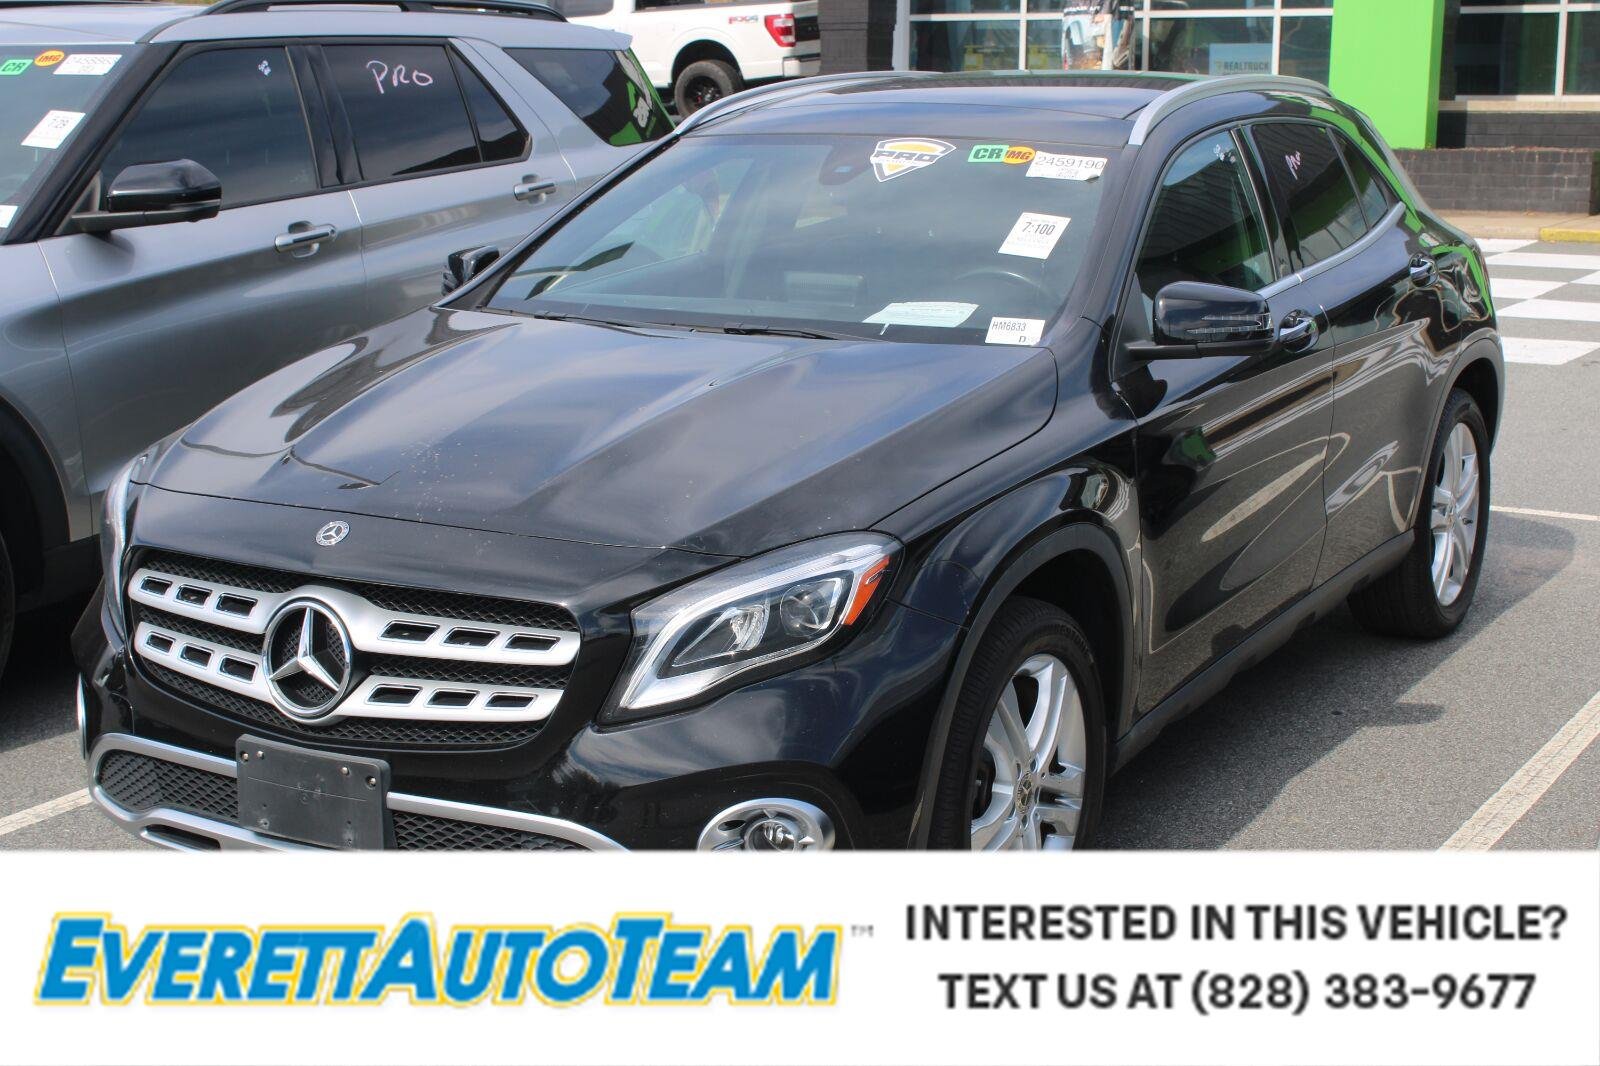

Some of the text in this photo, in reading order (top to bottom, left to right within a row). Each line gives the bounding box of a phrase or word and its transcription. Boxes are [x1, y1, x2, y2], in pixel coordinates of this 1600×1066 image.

[2, 62, 26, 72] CR
[366, 60, 433, 94] PRO
[873, 149, 943, 163] PRO
[973, 147, 1004, 160] CR
[1035, 155, 1105, 171] 2459190
[1022, 221, 1056, 235] 7:100
[991, 319, 1027, 333] HM6833
